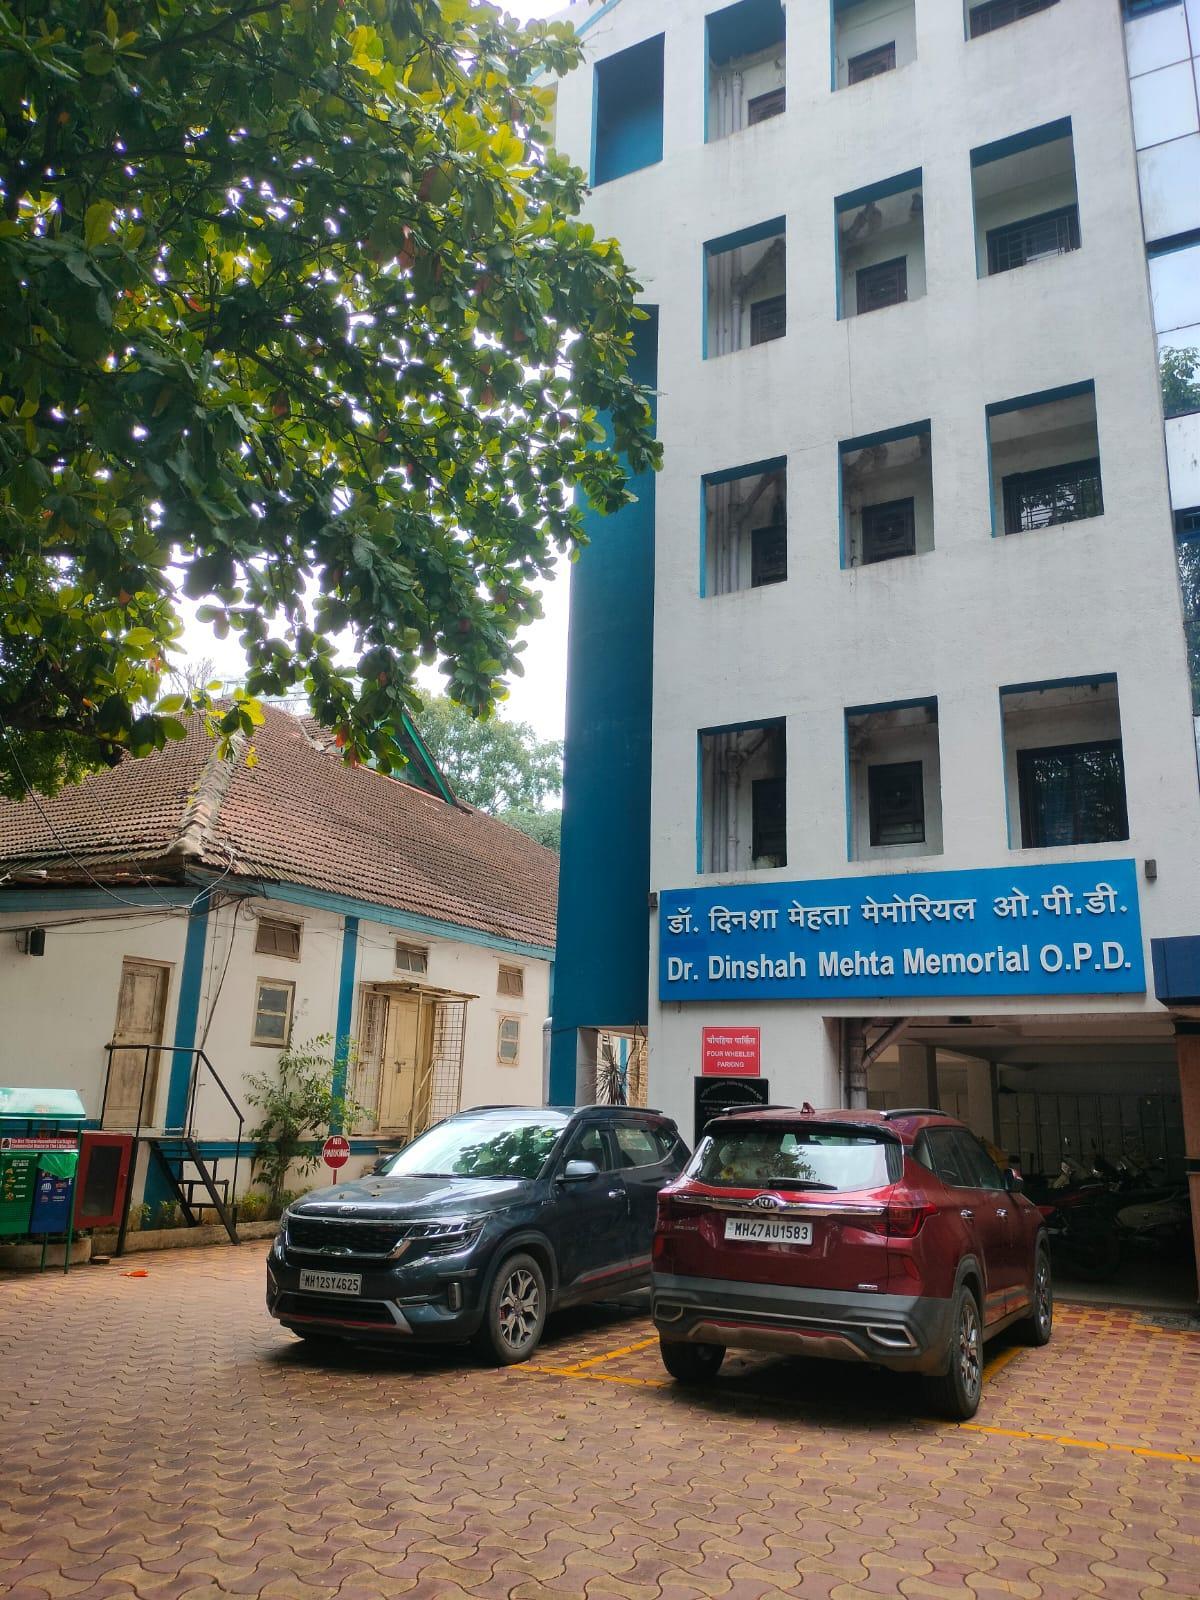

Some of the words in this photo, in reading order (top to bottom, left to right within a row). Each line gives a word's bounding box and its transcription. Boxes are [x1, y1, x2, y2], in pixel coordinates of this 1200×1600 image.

[667, 906, 699, 934] डॉ.
[708, 905, 779, 934] दिनशा
[787, 900, 851, 931] मेहता
[860, 893, 977, 924] मेमोरियल
[667, 956, 699, 981] Dr.
[708, 951, 807, 980] Dinshah
[818, 949, 895, 977] Mehta
[903, 944, 1030, 975] Memorial
[1039, 941, 1132, 972] O.P.D.
[724, 1050, 755, 1058] WHEELER
[758, 1198, 776, 1208] KIA
[734, 1222, 809, 1240] MH47AU1583
[304, 1274, 359, 1291] MH12SY4625
